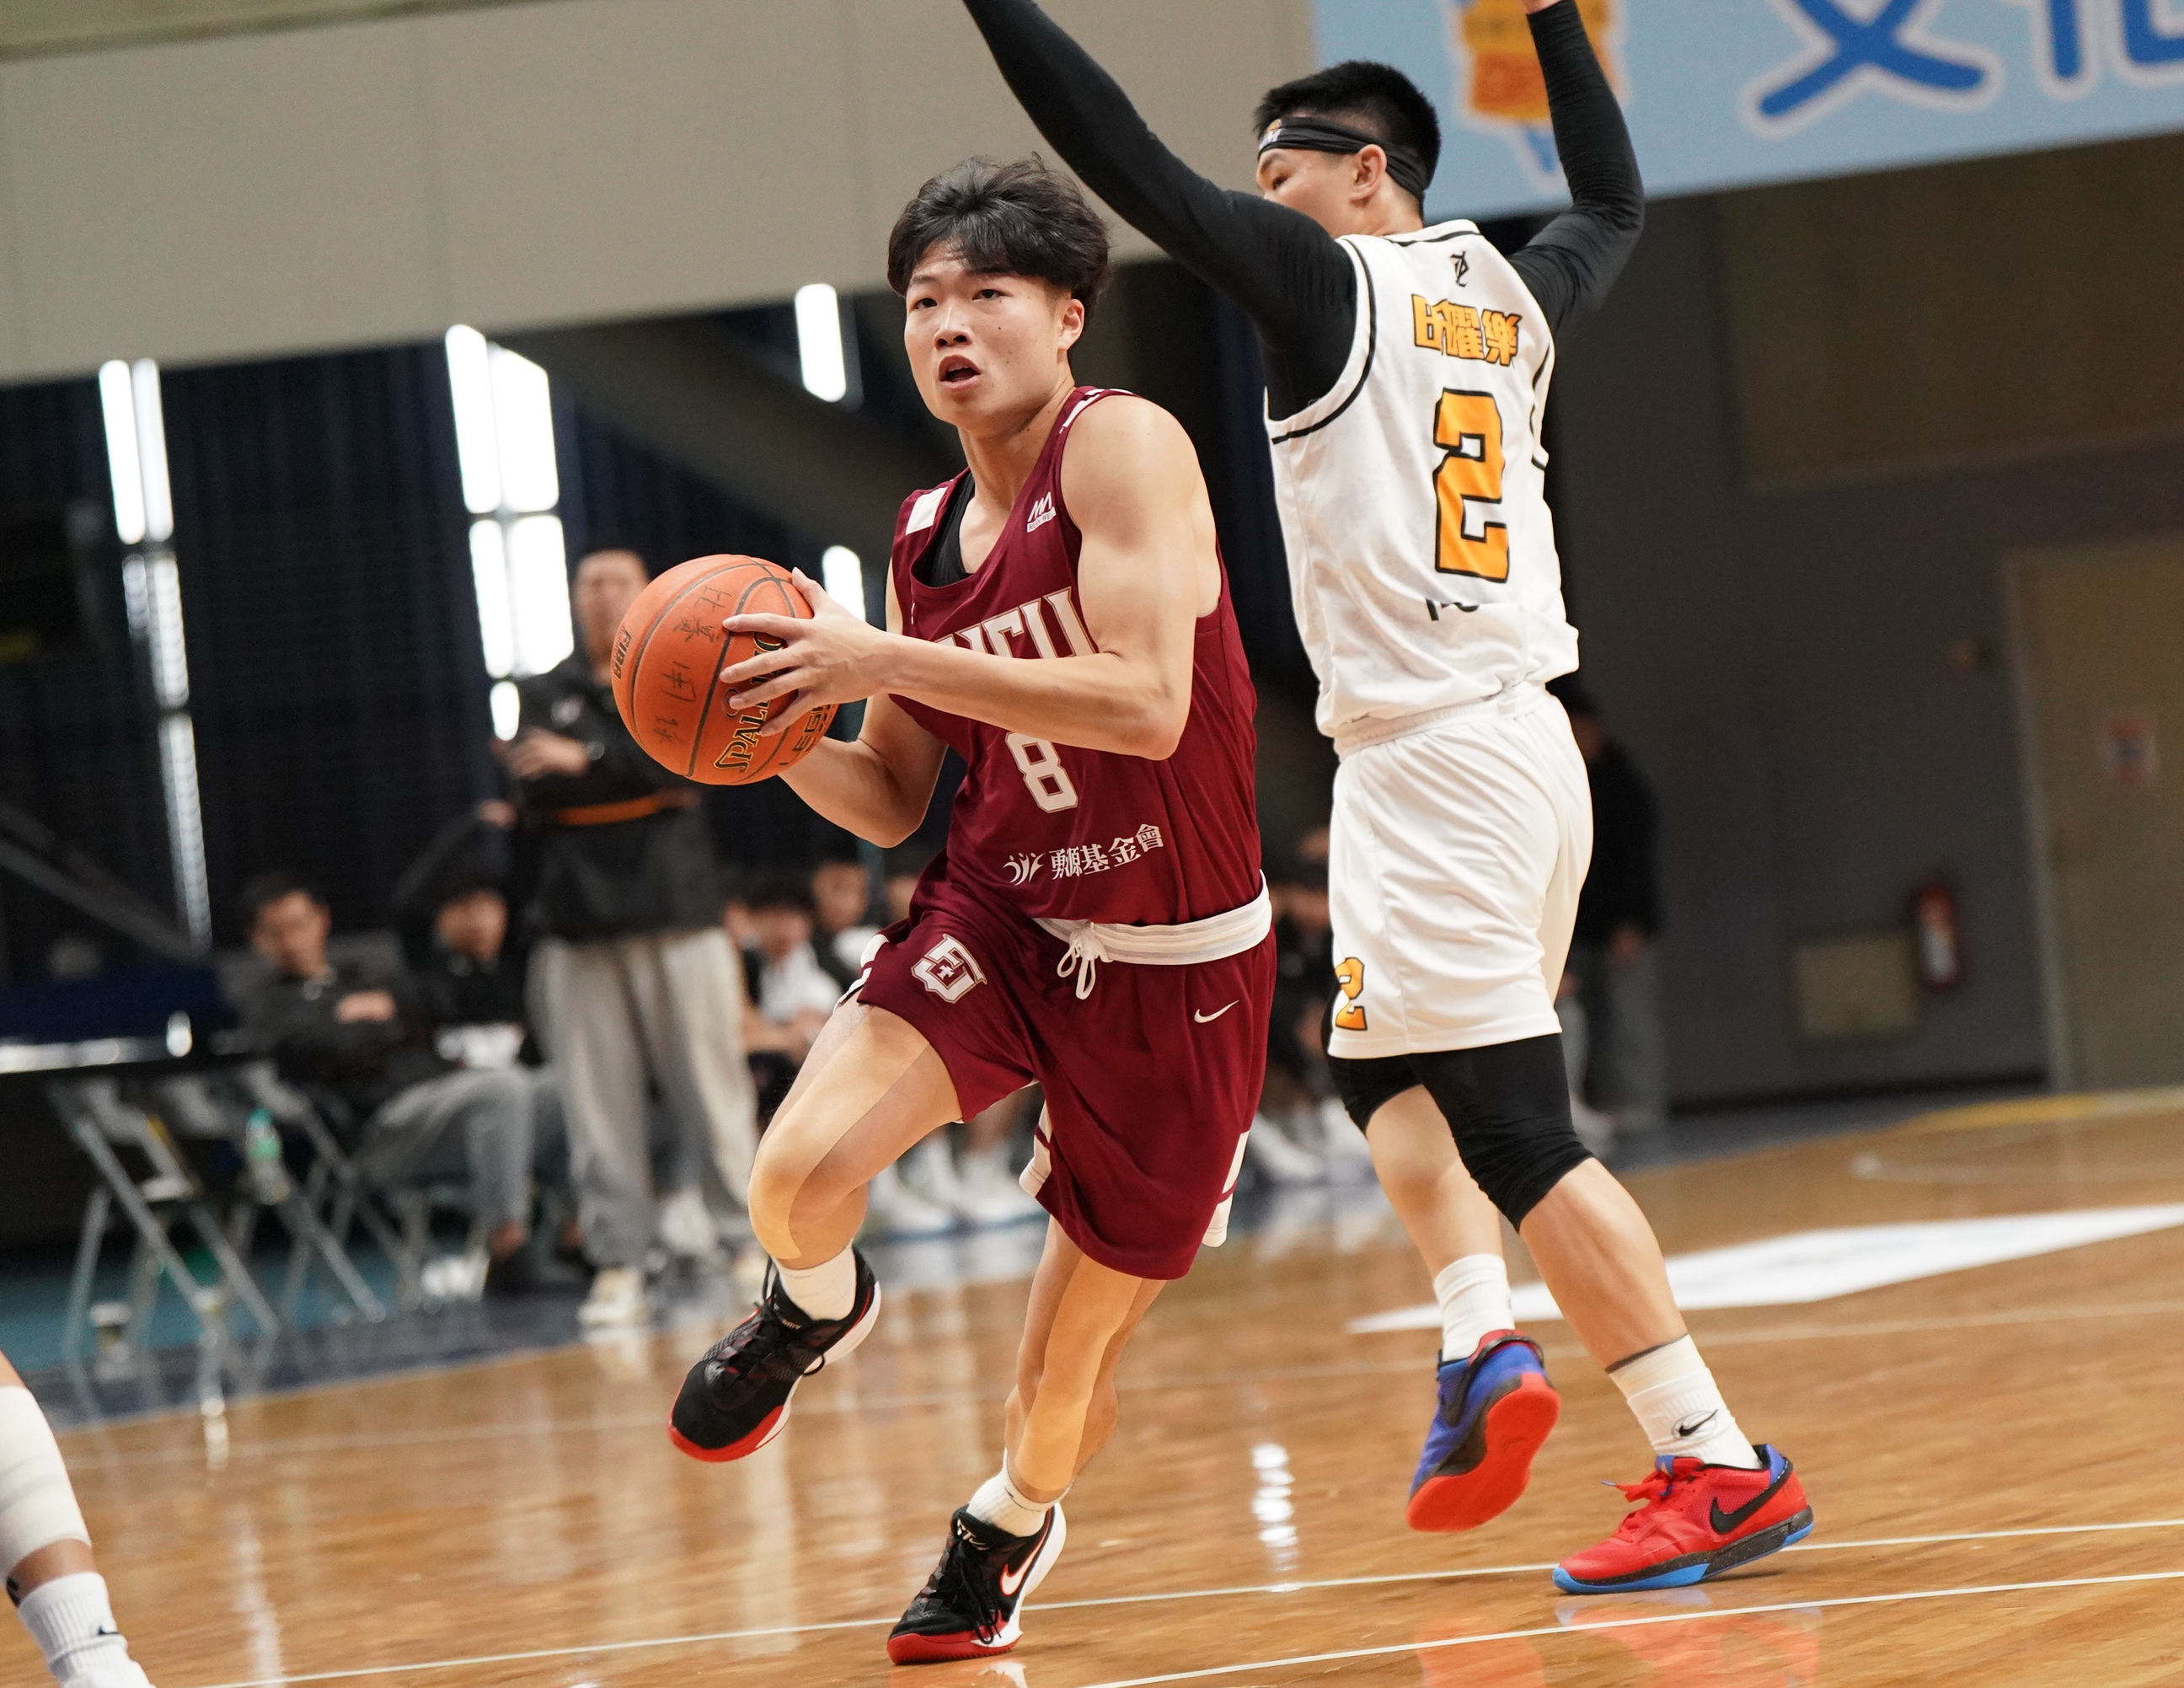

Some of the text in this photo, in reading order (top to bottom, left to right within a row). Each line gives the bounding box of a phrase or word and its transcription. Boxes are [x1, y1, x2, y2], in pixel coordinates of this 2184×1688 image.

[1433, 387, 1511, 584] 2
[1005, 731, 1079, 814] 8
[1334, 957, 1368, 1032] 2
